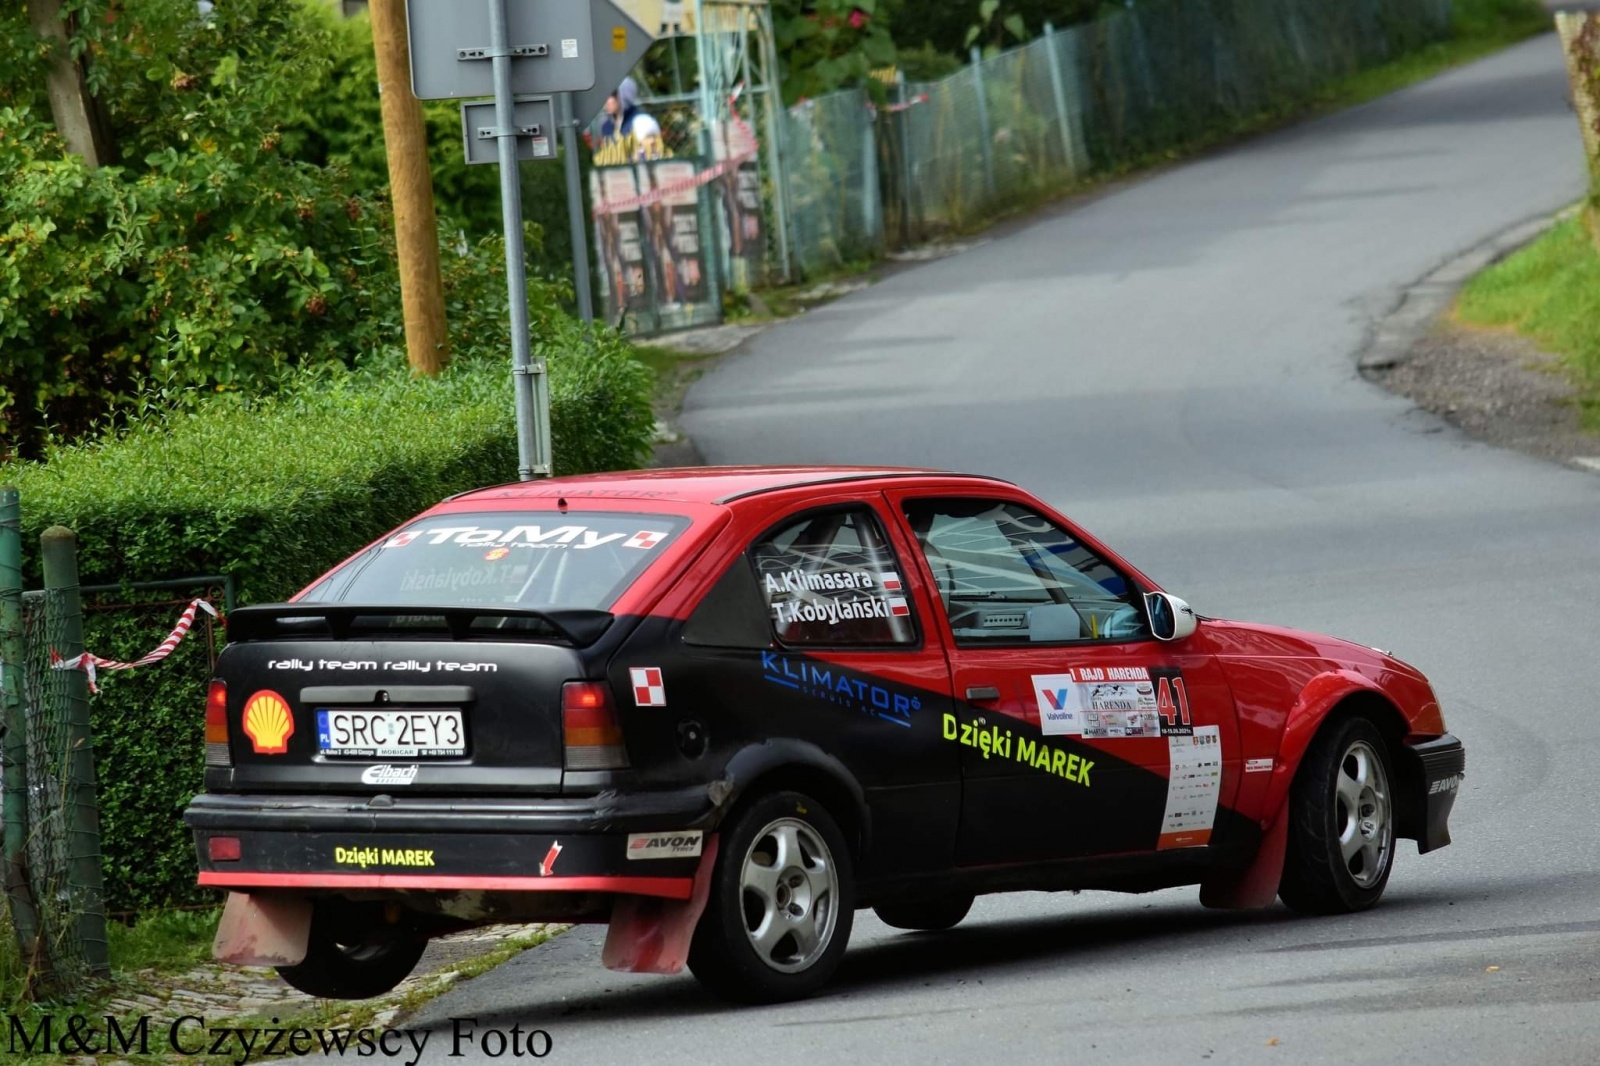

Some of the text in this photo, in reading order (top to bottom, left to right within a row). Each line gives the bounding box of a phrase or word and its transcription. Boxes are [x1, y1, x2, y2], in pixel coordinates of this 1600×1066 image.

[426, 525, 627, 549] ToMy
[765, 569, 873, 593] A.Klimasara
[771, 596, 890, 625] T.Kobylański
[268, 659, 498, 673] rally team rally team
[1069, 667, 1149, 680] 1 RAJD HARENDA
[1092, 700, 1132, 710] HARENDA
[1158, 677, 1191, 726] 41
[1046, 712, 1073, 721] Valvoline
[320, 734, 330, 743] PL
[334, 714, 460, 745] SRC 2EY3
[943, 713, 1095, 787] Dzięki MAREK
[361, 764, 419, 782] Eibach
[646, 836, 700, 849] AVON
[335, 847, 435, 868] Dzięki MAREK
